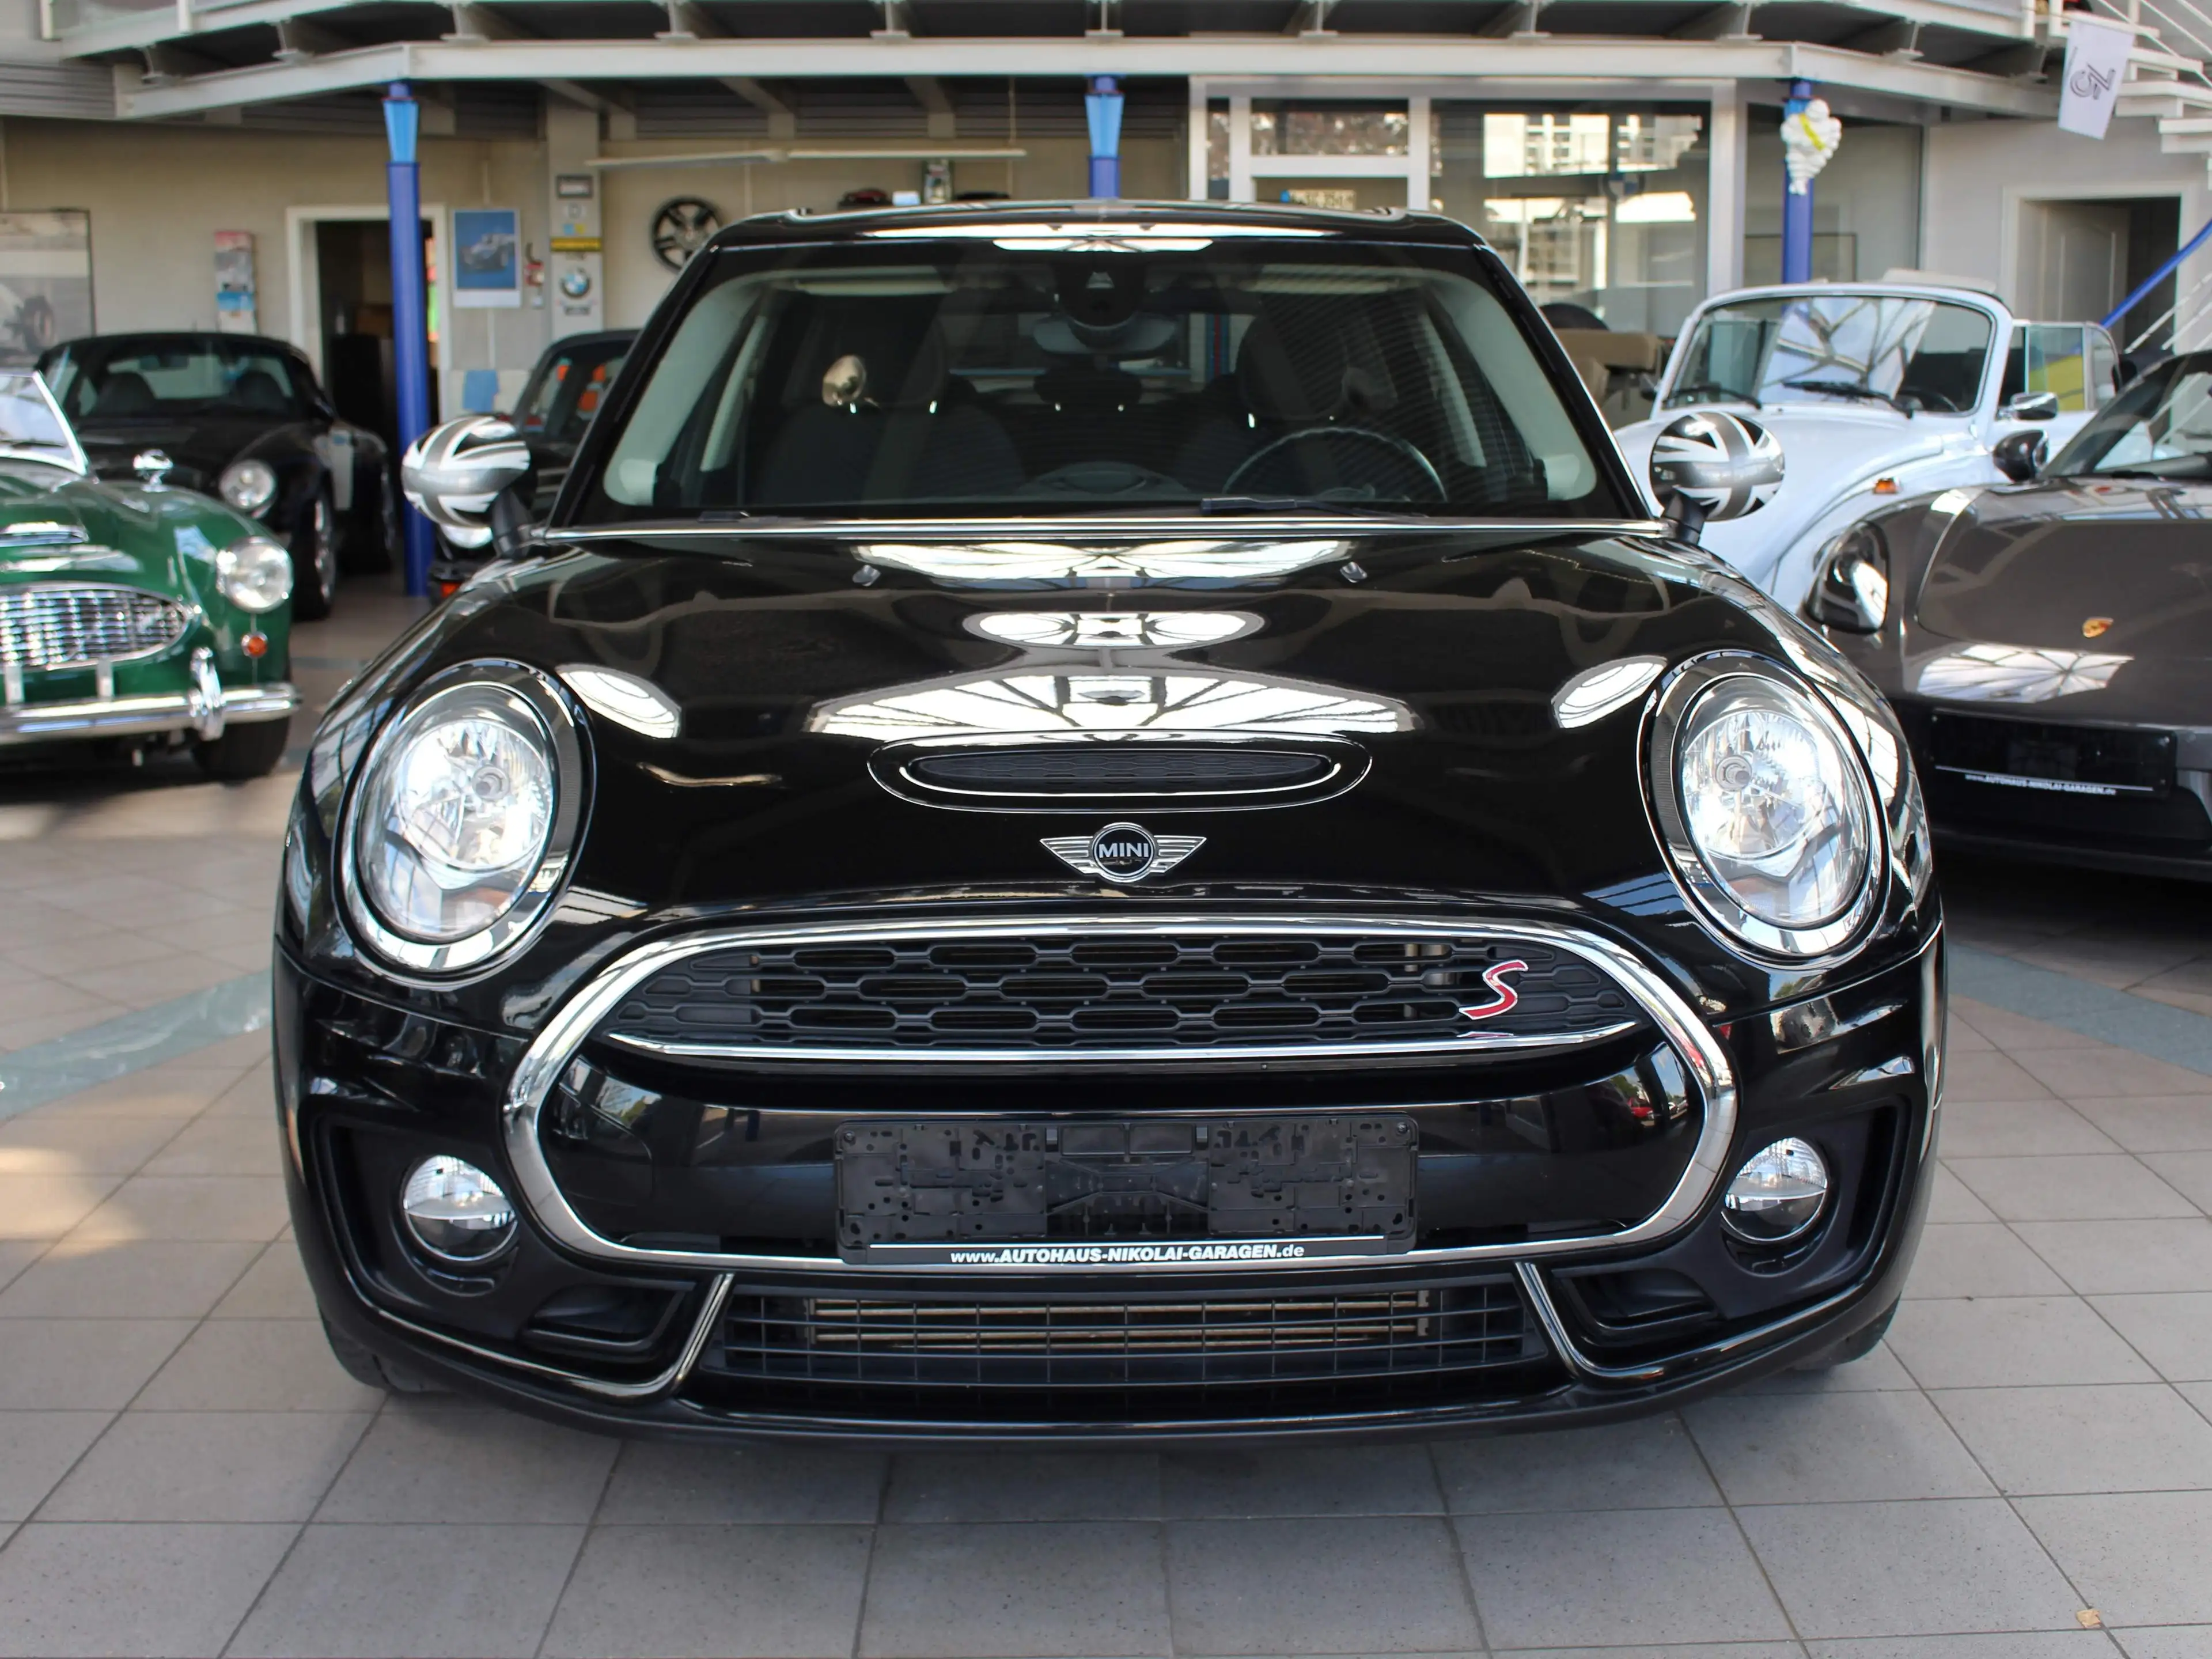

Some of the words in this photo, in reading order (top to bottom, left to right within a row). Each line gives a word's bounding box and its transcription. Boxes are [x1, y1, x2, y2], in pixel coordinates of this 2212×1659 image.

[1099, 843, 1149, 858] MINI
[1459, 959, 1528, 1020] S
[950, 1244, 1304, 1263] www.AUTOHAUS-NIKOLAI-GARAGEN.de
